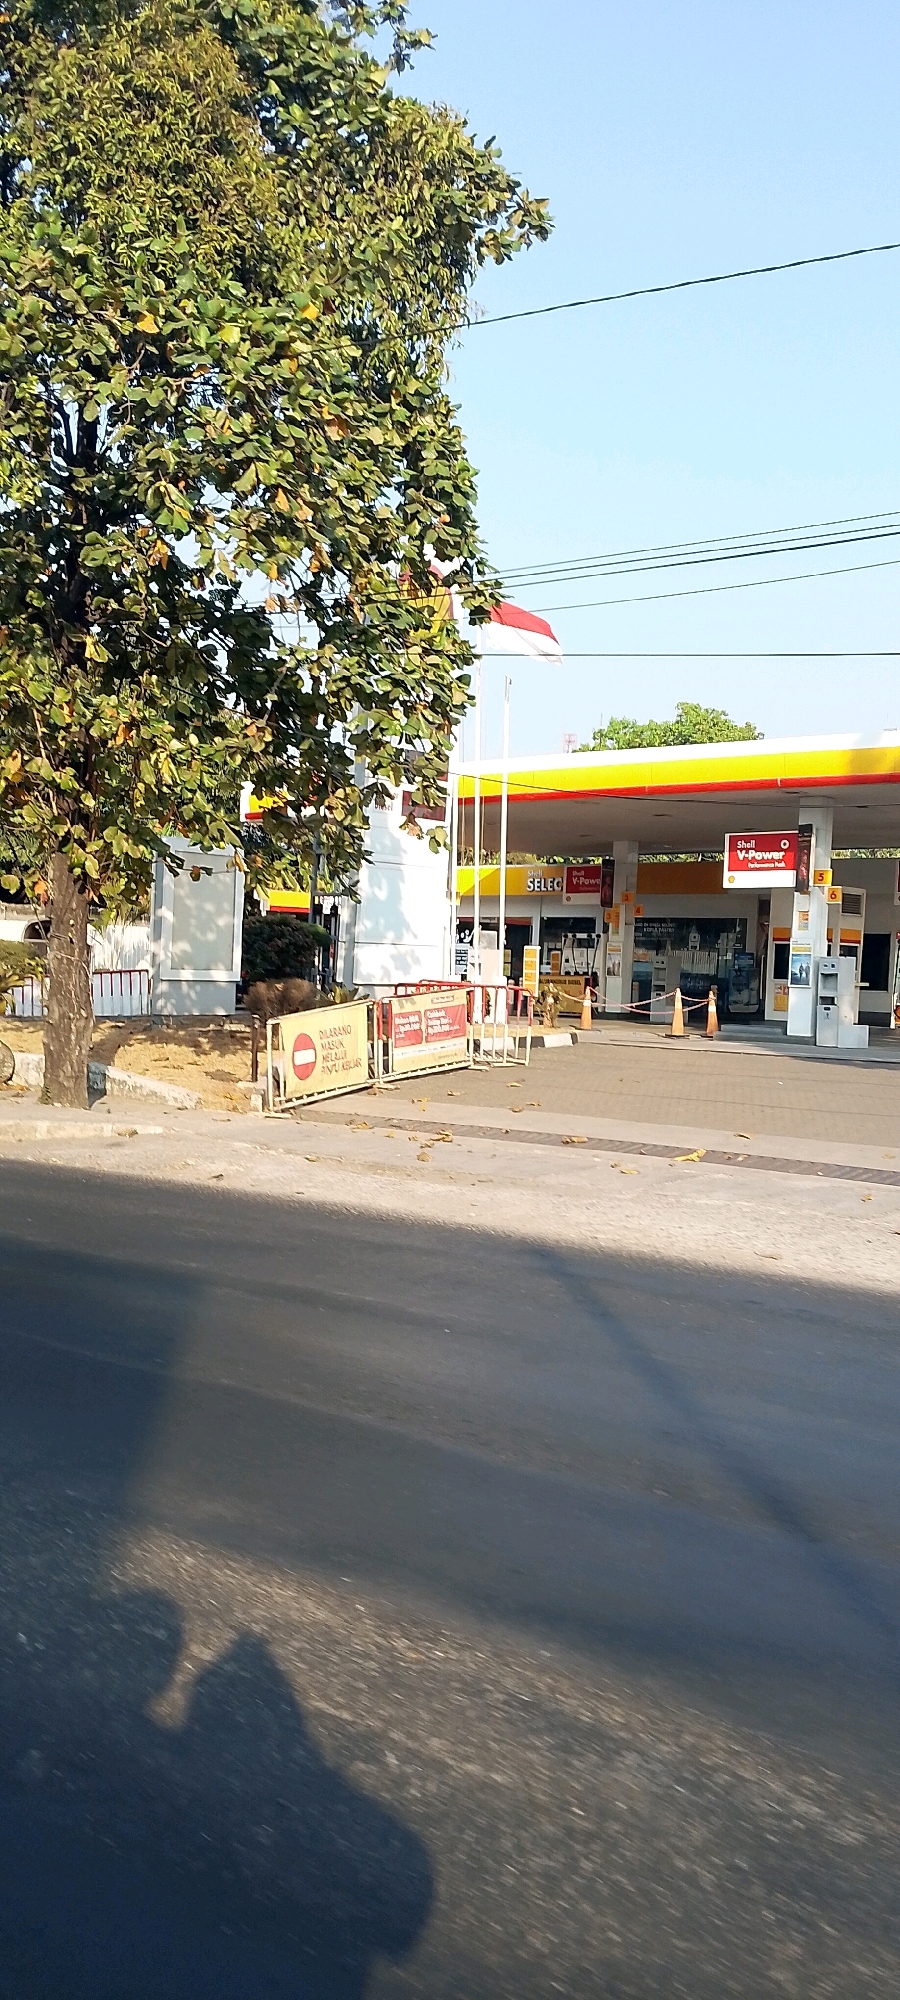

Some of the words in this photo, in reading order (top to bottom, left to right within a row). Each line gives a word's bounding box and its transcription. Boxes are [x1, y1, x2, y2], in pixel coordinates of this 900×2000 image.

[736, 839, 756, 849] Shell
[736, 849, 786, 861] V-Power
[527, 869, 543, 877] Shell
[817, 873, 825, 882] 5
[526, 877, 563, 892] SELEC
[572, 876, 601, 886] V-Powe
[829, 890, 838, 900] 6
